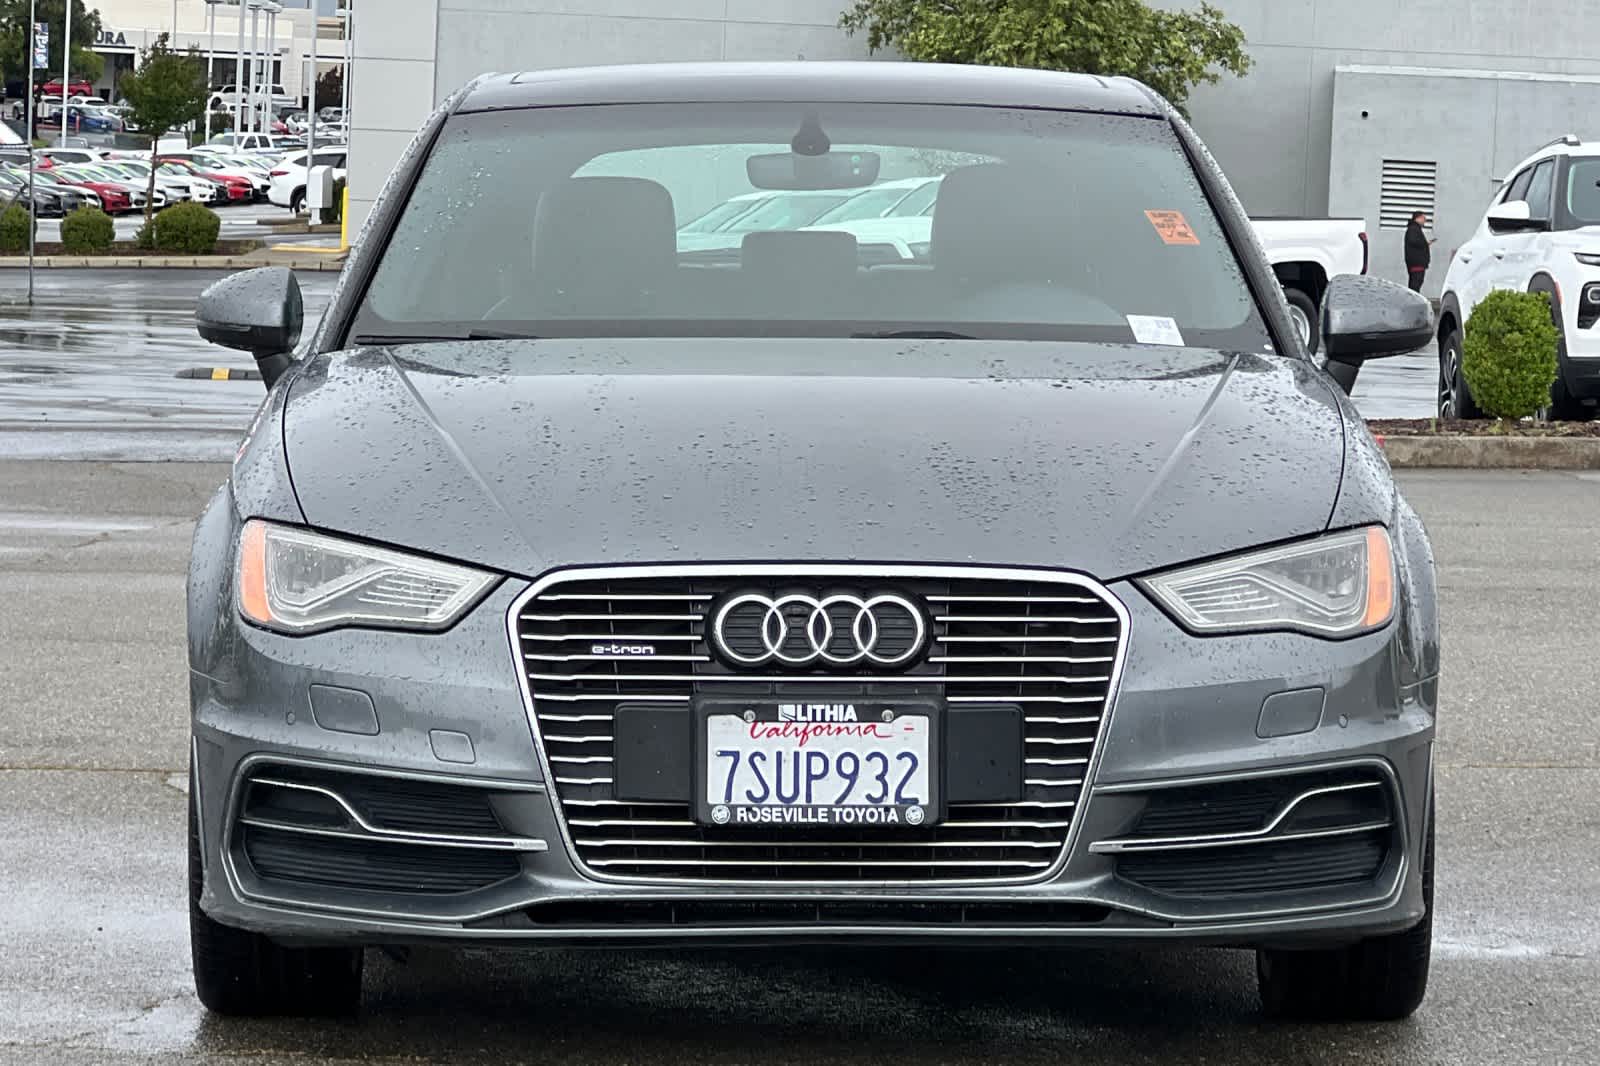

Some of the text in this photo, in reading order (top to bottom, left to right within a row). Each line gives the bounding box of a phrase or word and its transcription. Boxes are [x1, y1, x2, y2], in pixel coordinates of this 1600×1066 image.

[95, 31, 126, 45] URA
[592, 644, 654, 654] e-tron
[796, 704, 857, 721] LITHIA
[750, 721, 893, 747] California
[716, 750, 919, 805] 7SUP932
[736, 807, 899, 823] ROSEVILLE TOYOTA
